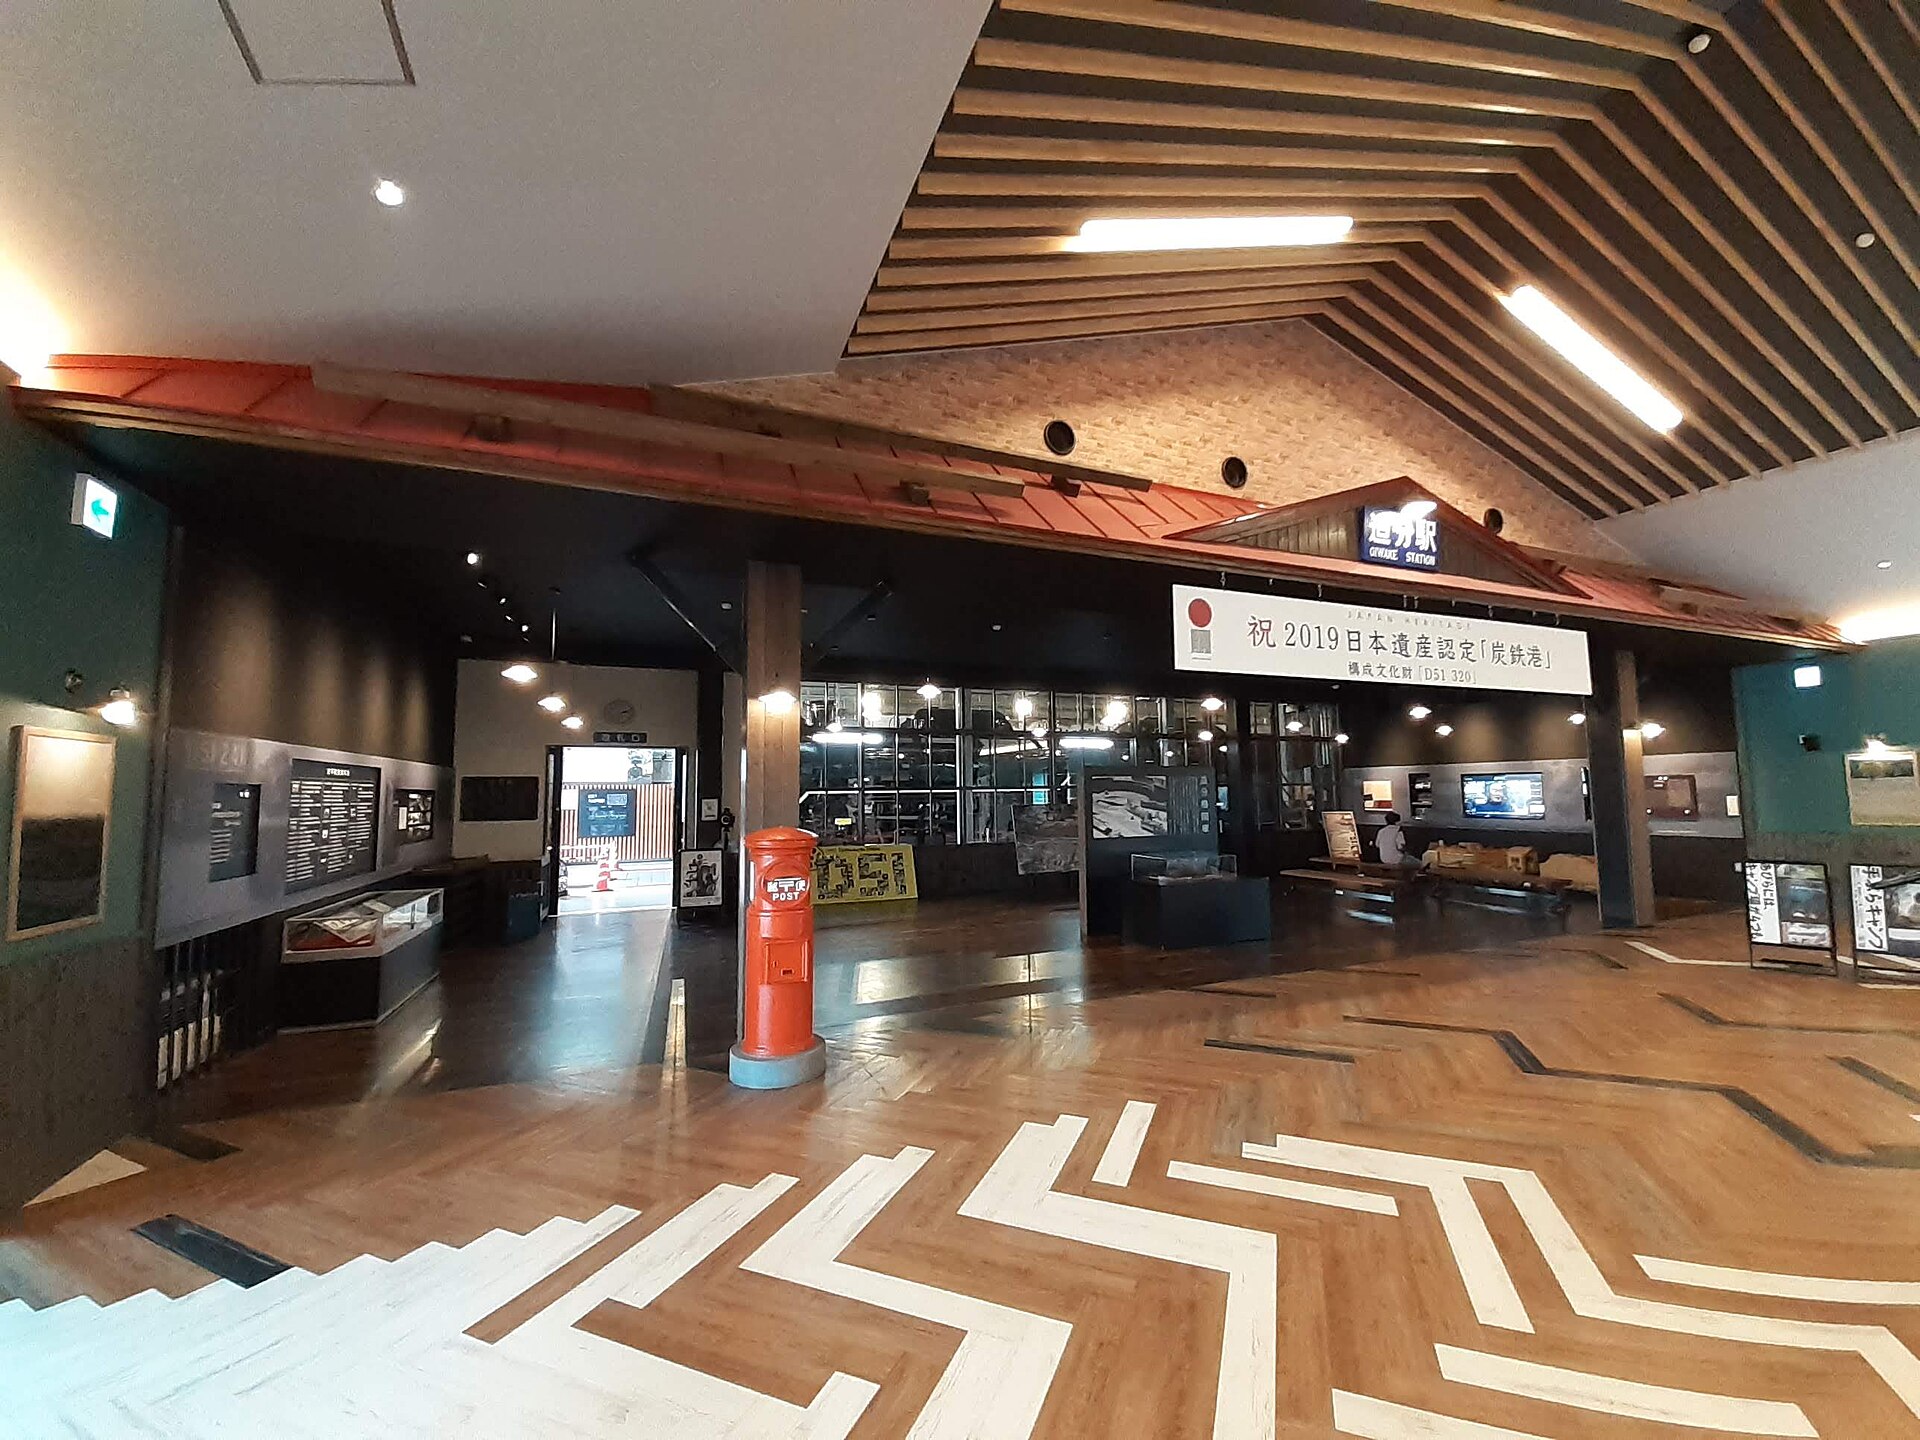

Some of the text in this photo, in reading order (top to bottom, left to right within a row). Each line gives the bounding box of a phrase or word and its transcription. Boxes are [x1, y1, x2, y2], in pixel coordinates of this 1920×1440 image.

[1405, 551, 1436, 566] STATION
[1347, 610, 1394, 623] JAPAN
[772, 891, 800, 902] POST
